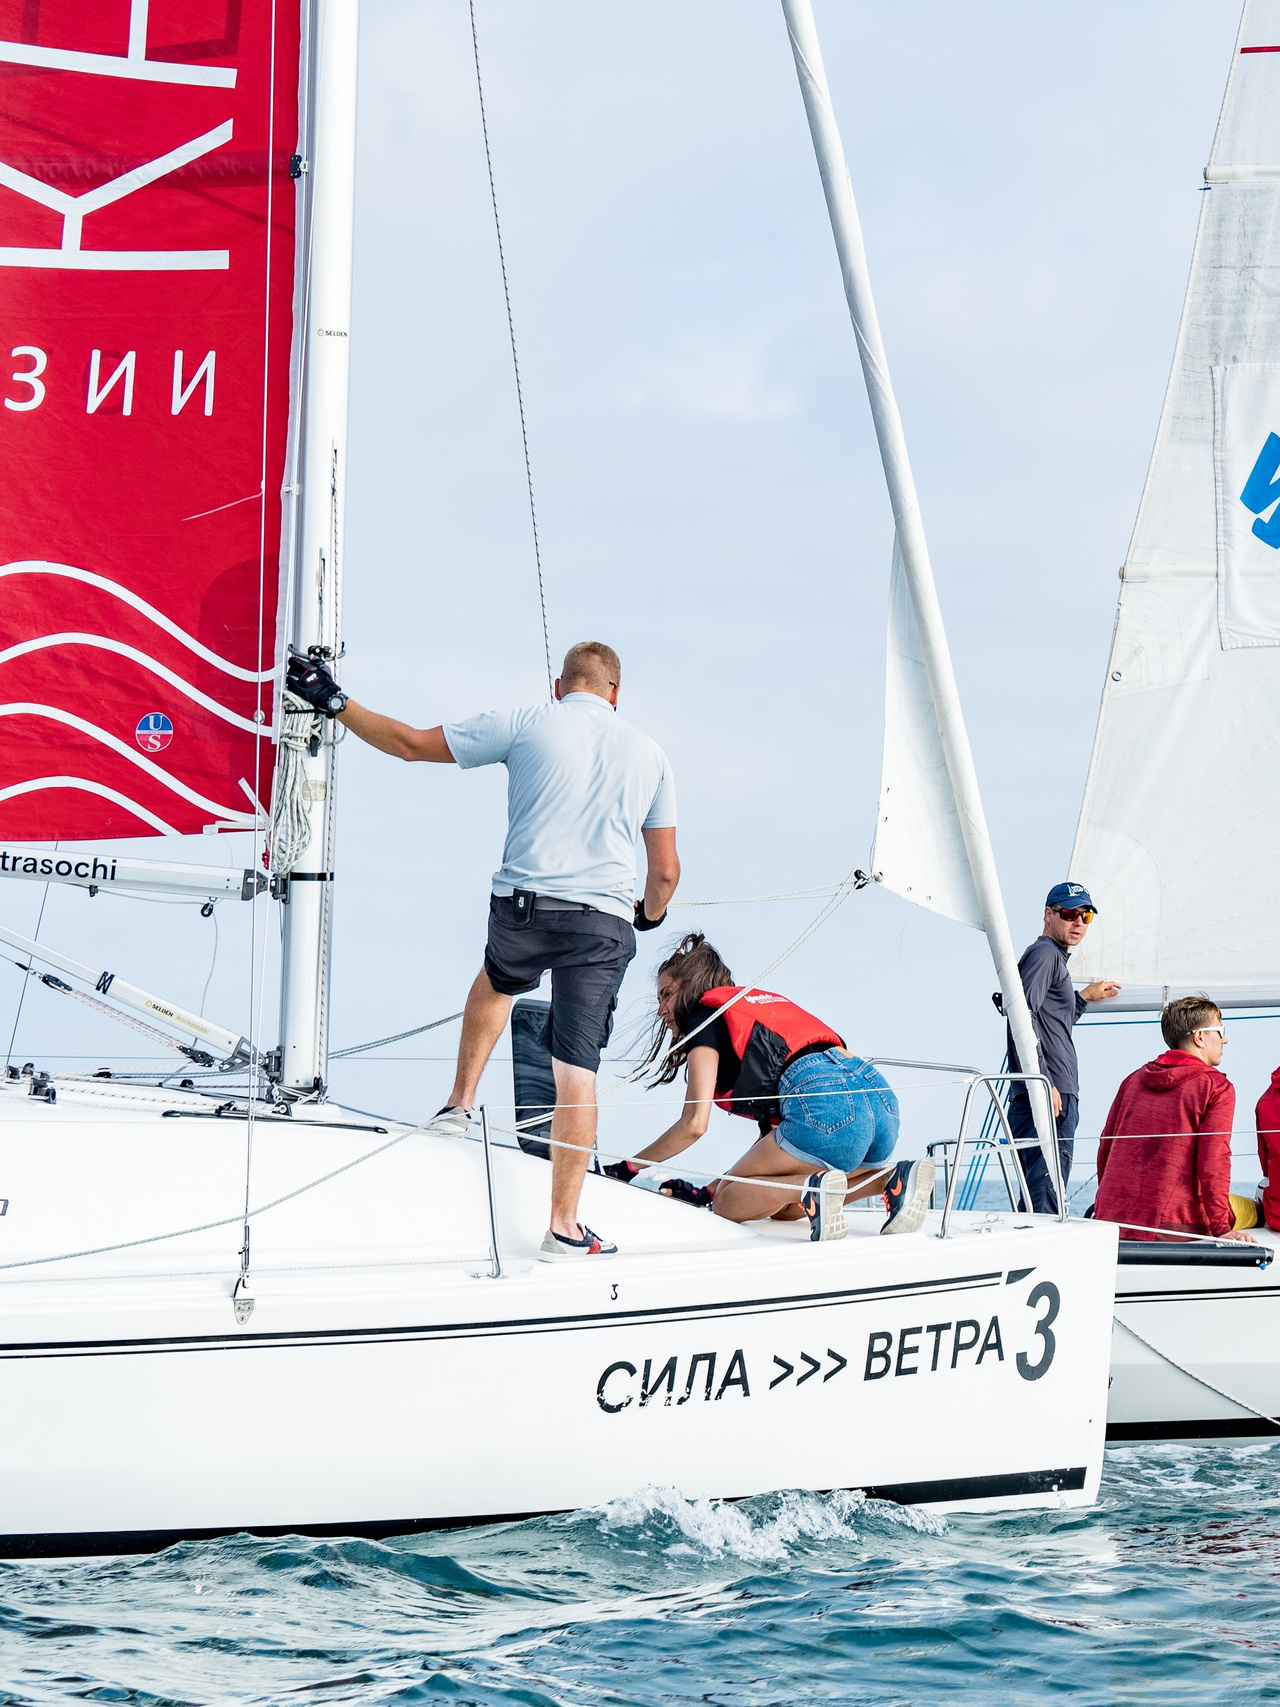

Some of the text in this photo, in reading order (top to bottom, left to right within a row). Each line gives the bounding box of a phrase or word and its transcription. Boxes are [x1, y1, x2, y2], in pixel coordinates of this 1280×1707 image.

[0, 851, 117, 880] trasochi
[597, 1281, 1061, 1414] СИЛА ВЕТРА 3
